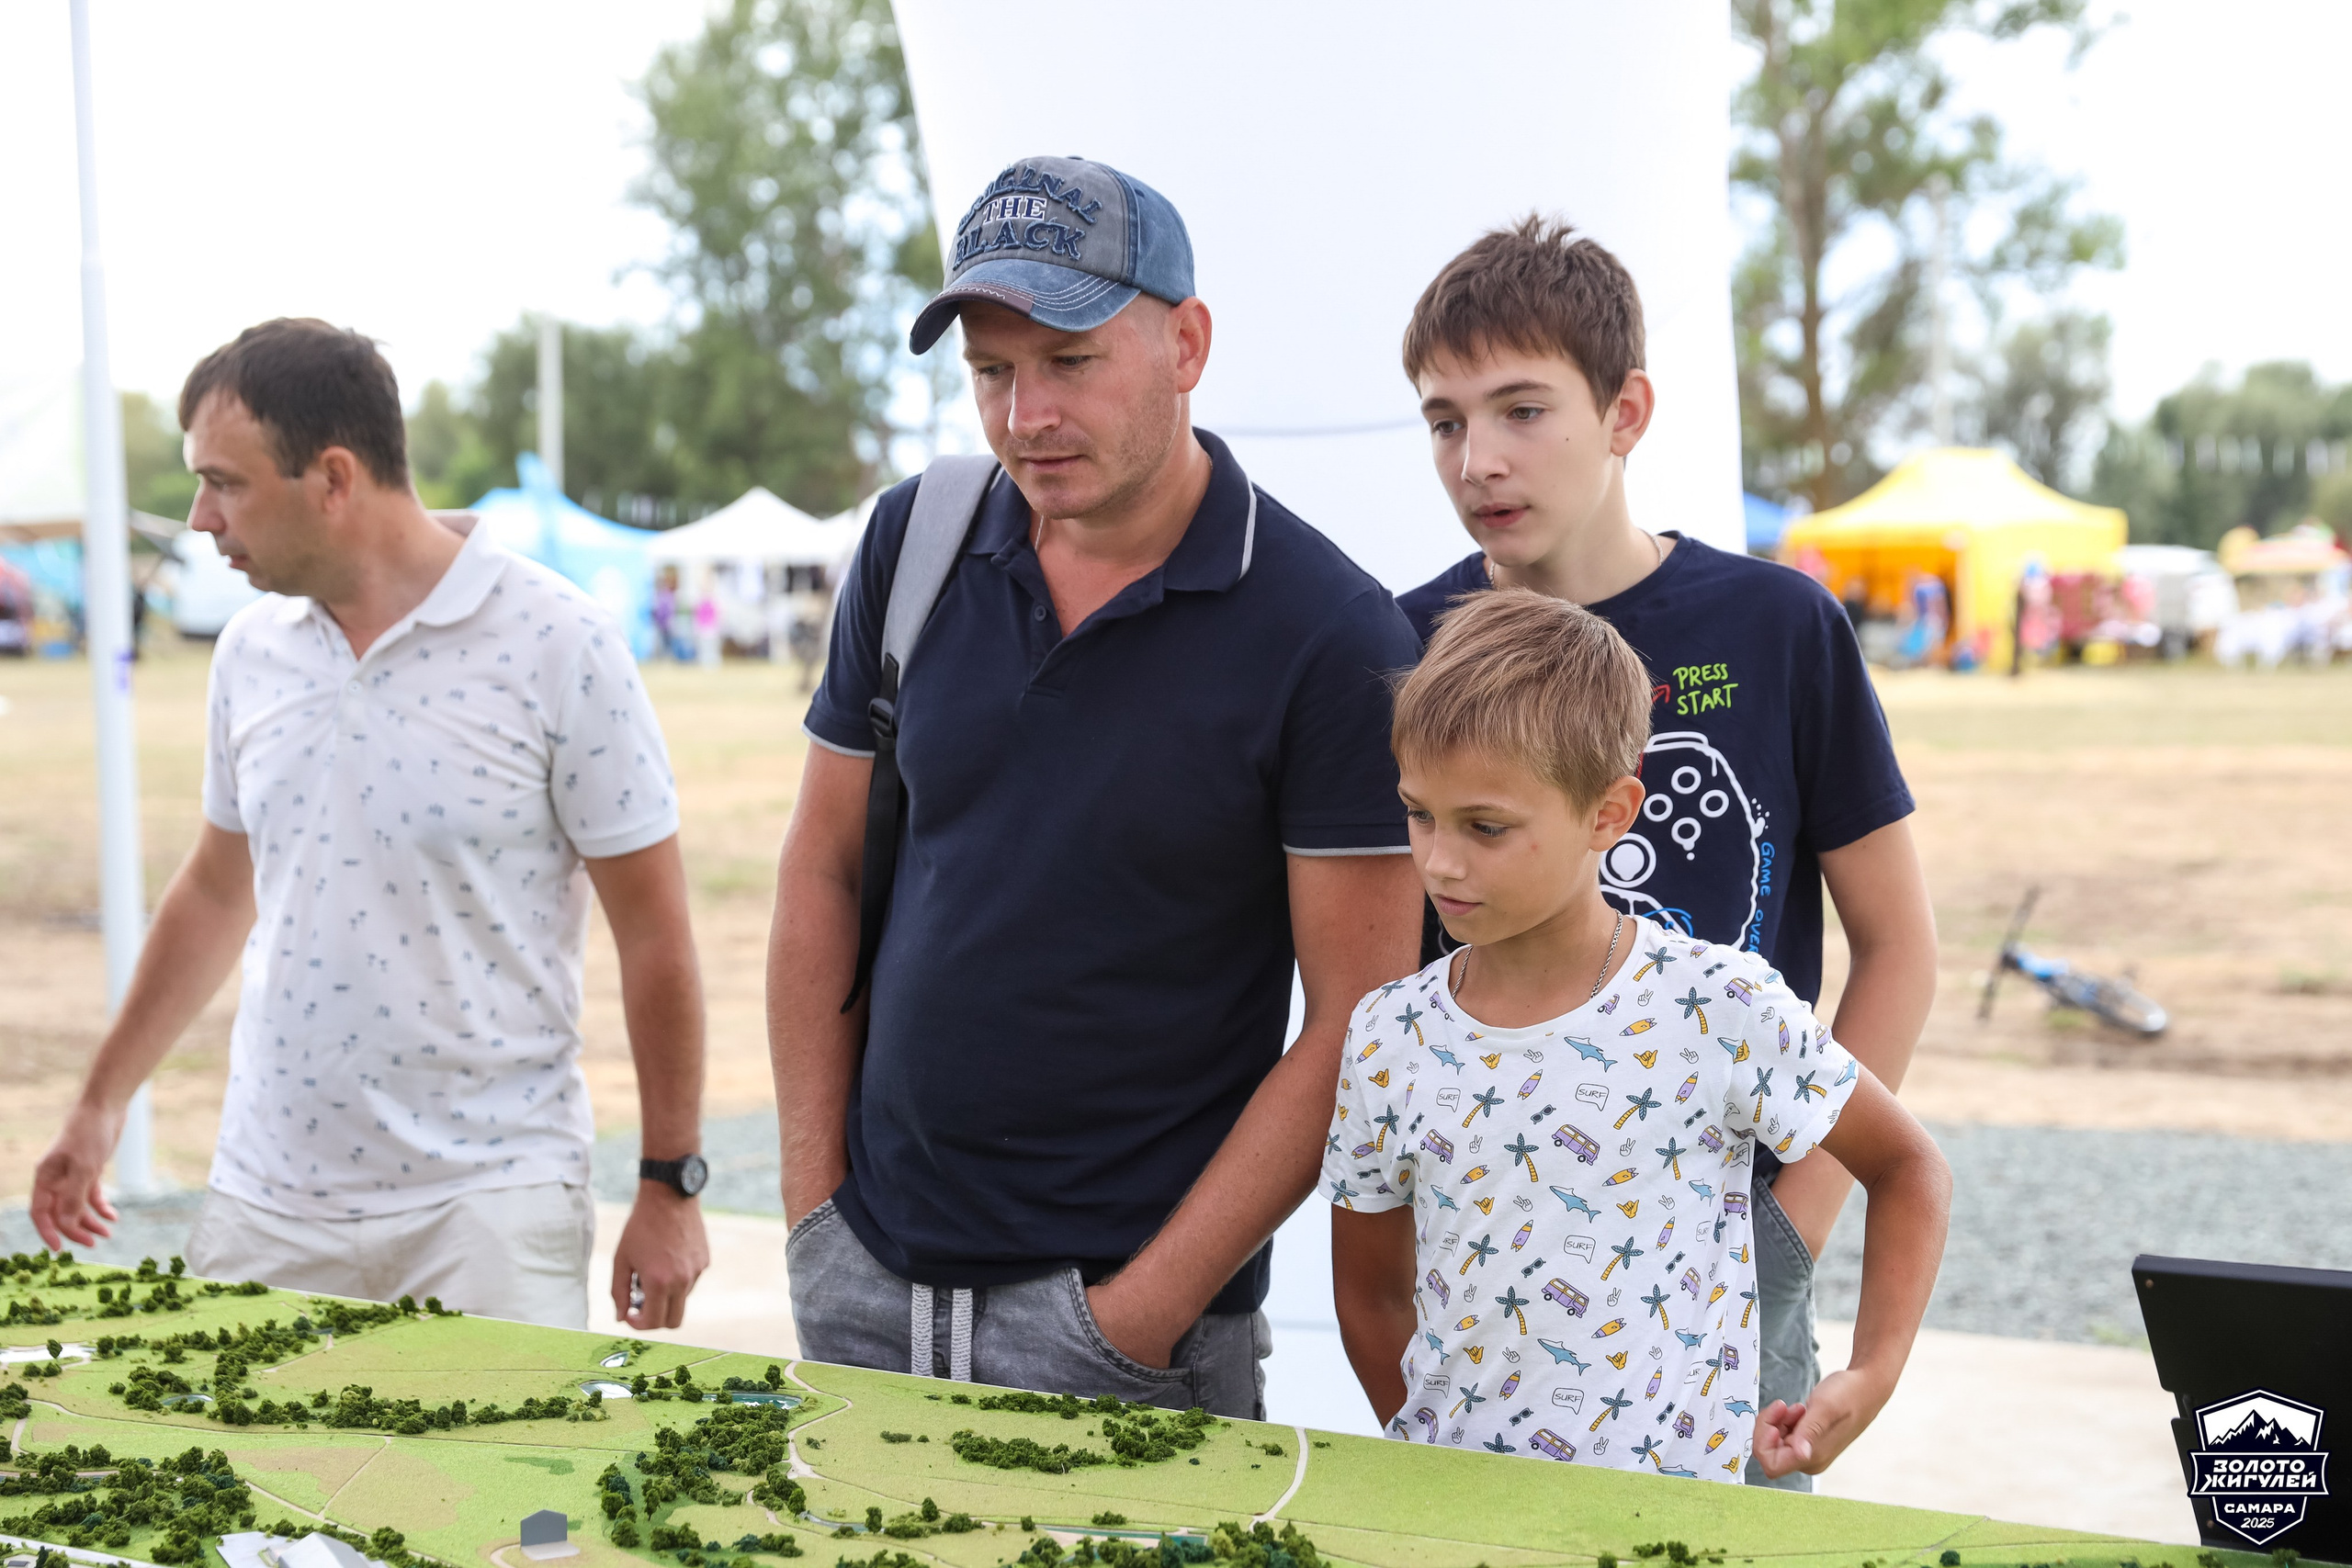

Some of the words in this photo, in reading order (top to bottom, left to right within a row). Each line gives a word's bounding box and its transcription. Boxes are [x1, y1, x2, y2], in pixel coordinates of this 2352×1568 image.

[982, 195, 1047, 225] THE
[953, 219, 1085, 271] BLACK
[1672, 662, 1728, 690] PRESS
[1677, 682, 1738, 715] START
[1759, 841, 1775, 897] GAME
[1438, 1093, 1459, 1101] SURF
[1577, 1089, 1607, 1099] SURF
[1566, 1240, 1593, 1250] SURF
[1425, 1379, 1449, 1387] SURF
[1554, 1393, 1582, 1403] SURF
